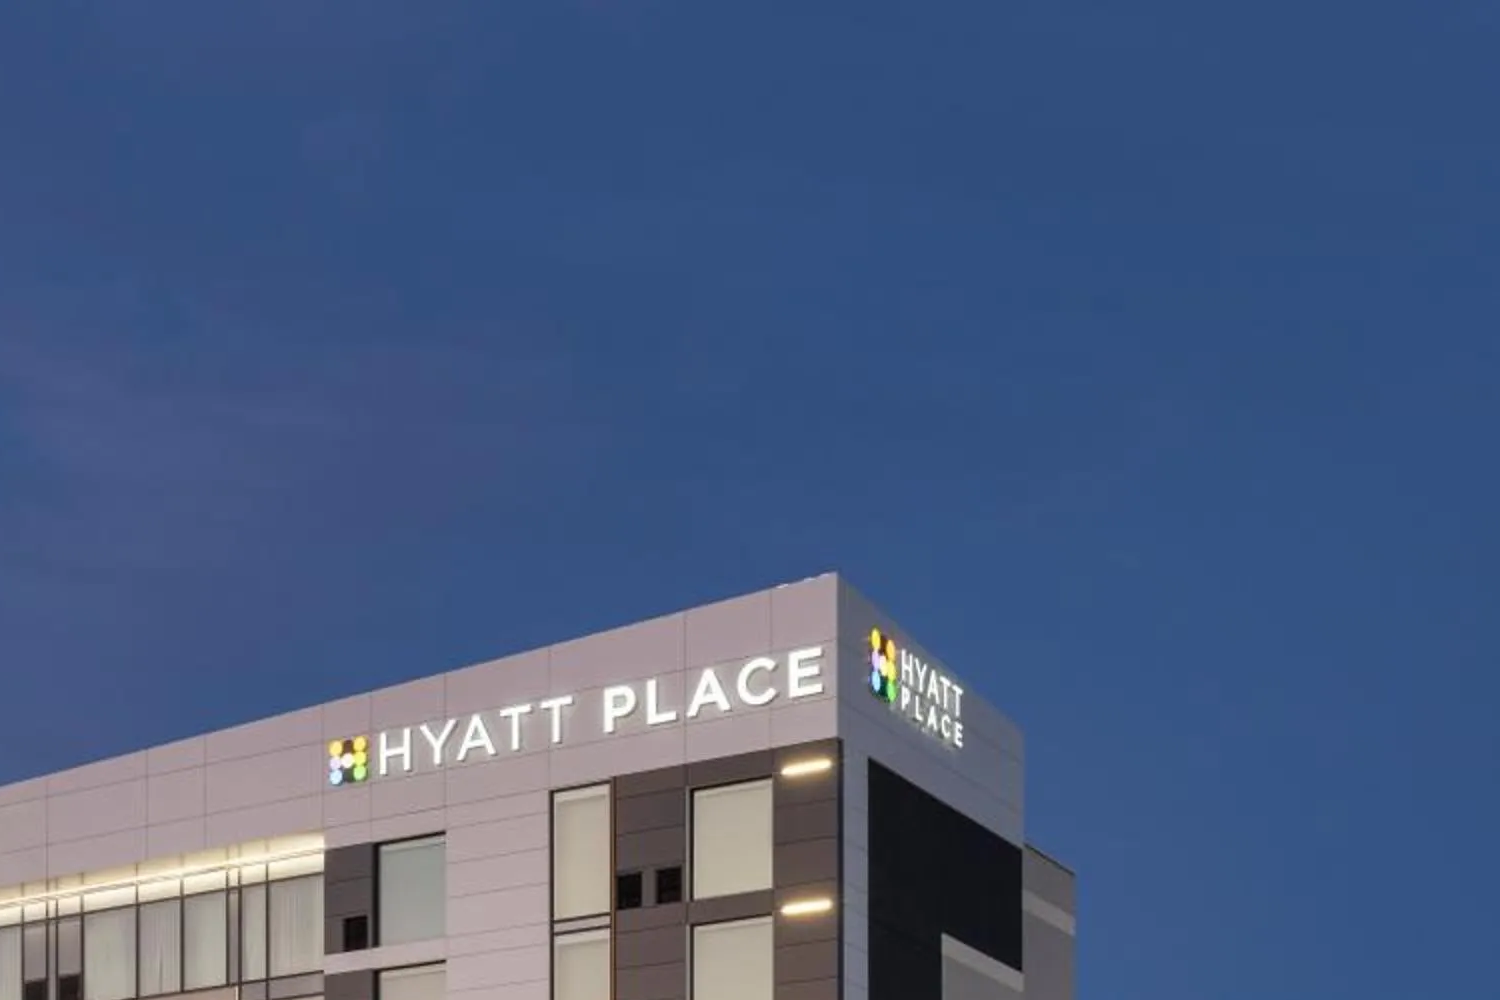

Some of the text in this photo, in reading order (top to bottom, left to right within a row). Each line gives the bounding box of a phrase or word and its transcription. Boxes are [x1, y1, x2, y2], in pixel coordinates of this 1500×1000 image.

[379, 646, 825, 775] HYATT PLACE
[901, 648, 964, 717] HYATT
[901, 687, 964, 748] PLACE
